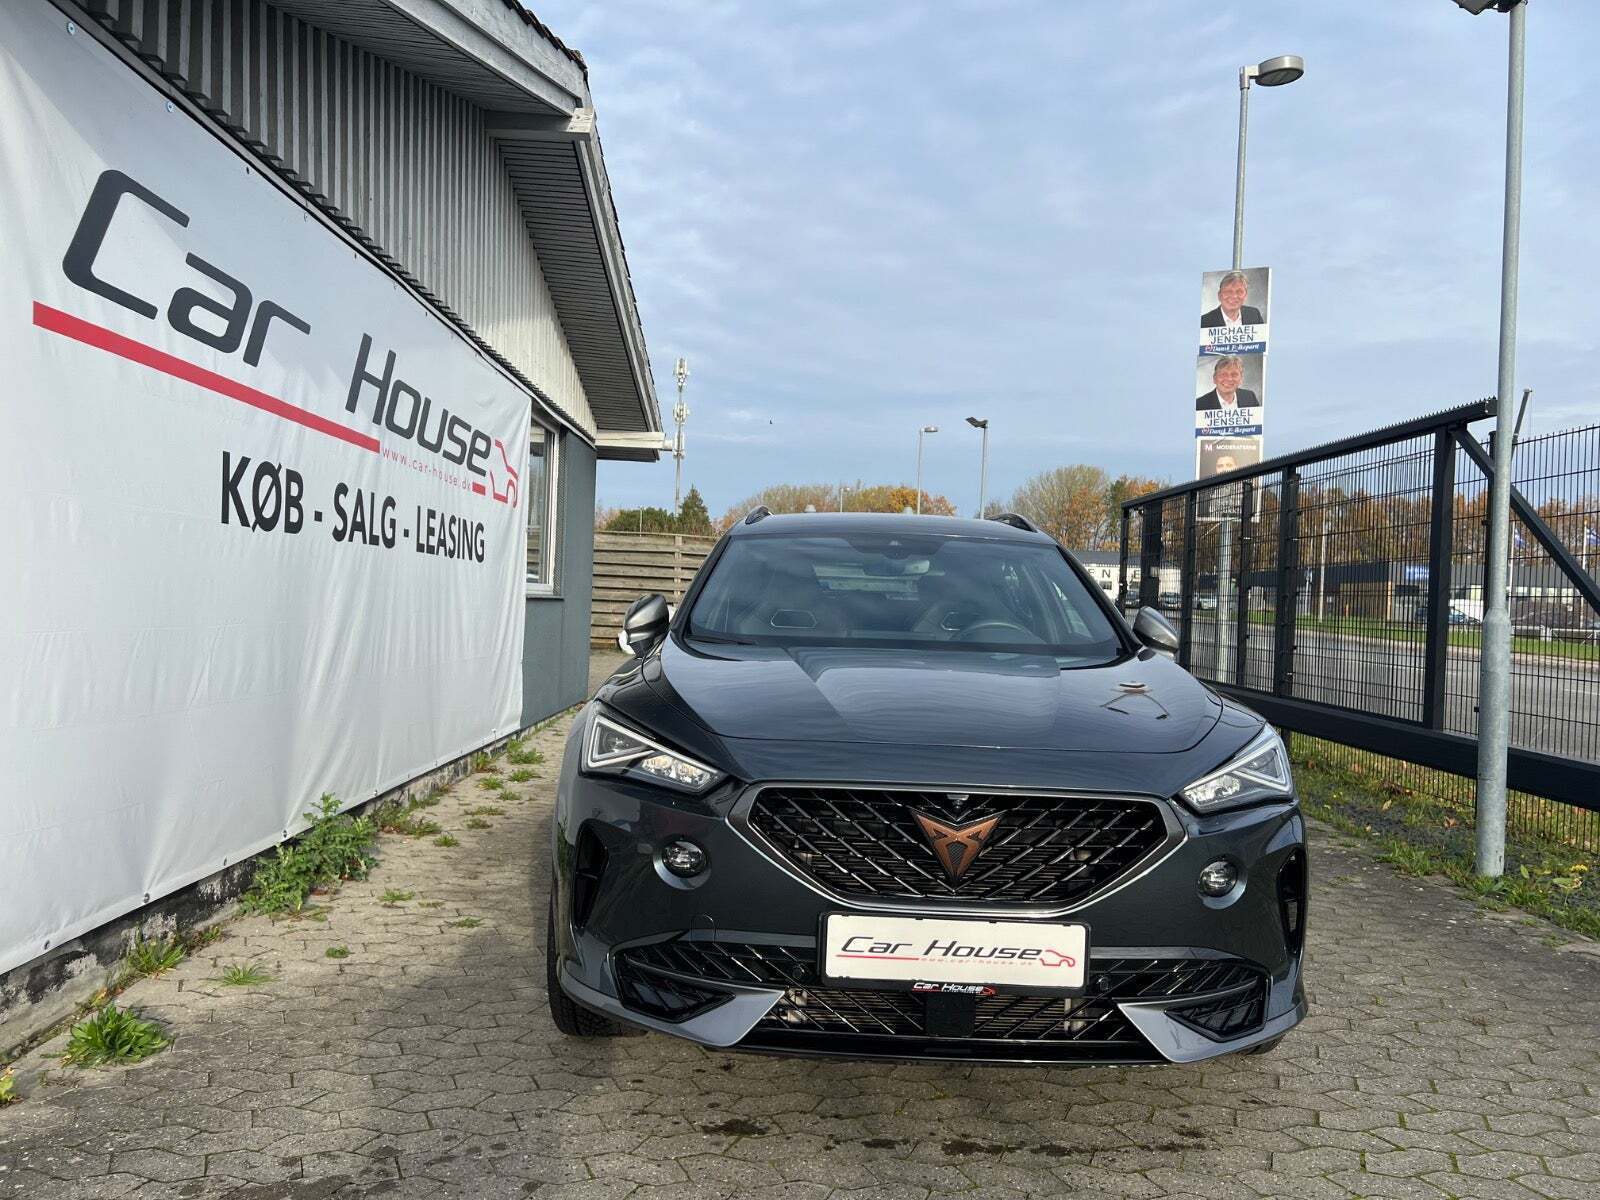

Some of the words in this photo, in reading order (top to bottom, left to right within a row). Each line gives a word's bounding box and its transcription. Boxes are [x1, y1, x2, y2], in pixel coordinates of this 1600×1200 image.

[62, 169, 312, 368] Car
[345, 332, 492, 478] House
[1208, 326, 1257, 337] MICHAEL
[1210, 334, 1254, 345] JENSEN
[1204, 408, 1253, 419] MICHAEL
[1207, 416, 1250, 427] JENSEN
[221, 450, 304, 535] KØB
[331, 481, 396, 549] SALG
[416, 505, 485, 563] LEASING
[841, 936, 913, 954] Car
[922, 939, 1042, 960] House
[913, 981, 940, 990] Car
[941, 983, 984, 993] House
